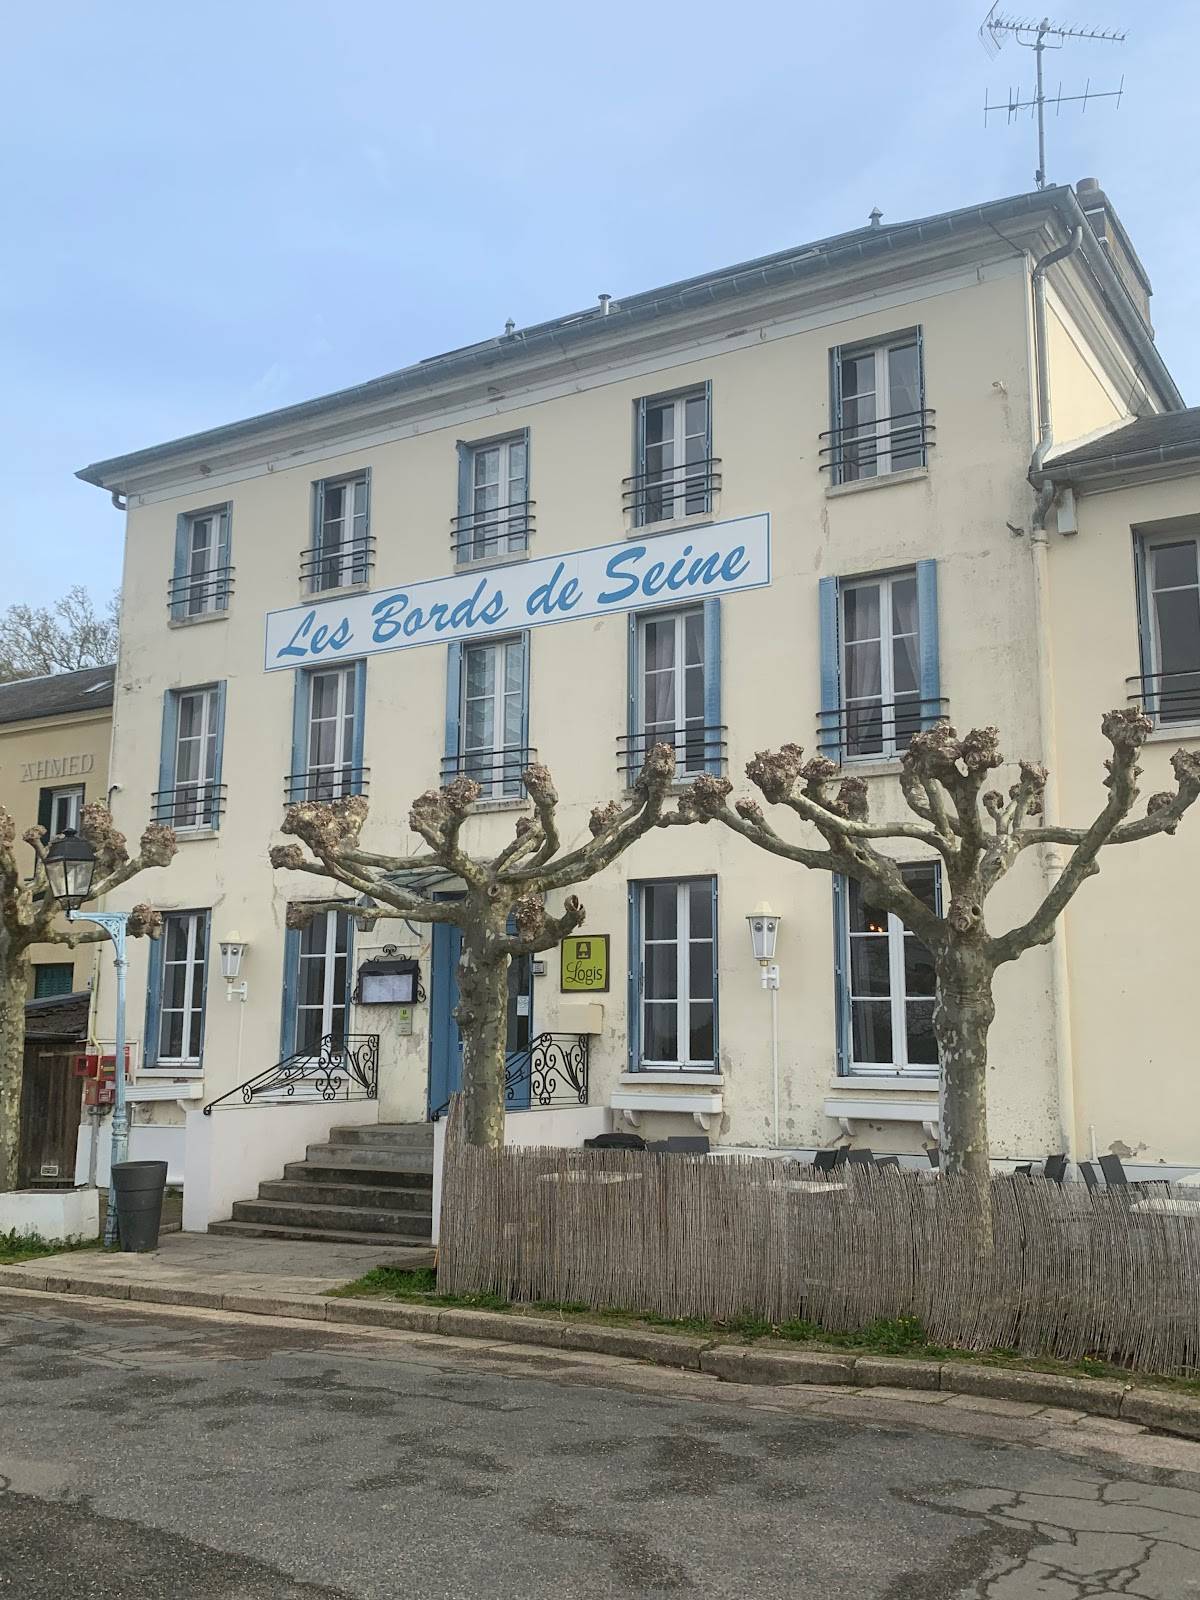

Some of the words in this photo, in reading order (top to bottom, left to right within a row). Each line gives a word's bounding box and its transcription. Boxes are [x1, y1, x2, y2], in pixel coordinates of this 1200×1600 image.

[276, 610, 353, 657] Les
[371, 577, 508, 644] Bords
[526, 561, 583, 615] de
[597, 544, 750, 604] Seine
[20, 754, 94, 782] AHMED
[566, 961, 603, 985] Logis
